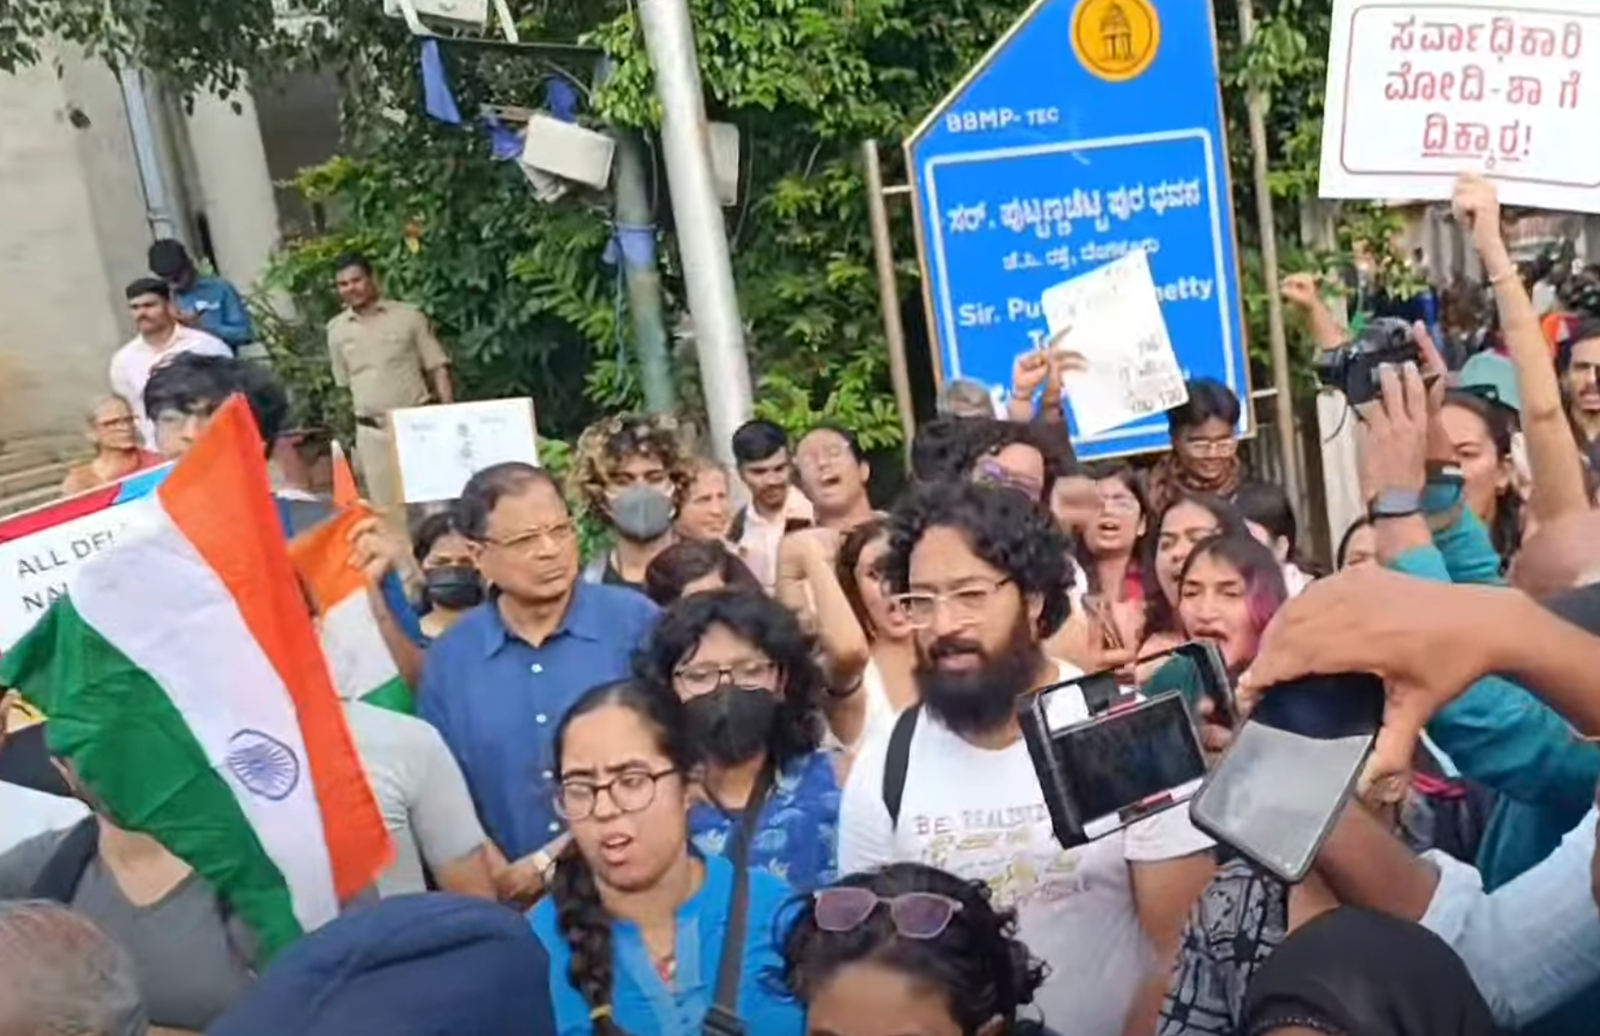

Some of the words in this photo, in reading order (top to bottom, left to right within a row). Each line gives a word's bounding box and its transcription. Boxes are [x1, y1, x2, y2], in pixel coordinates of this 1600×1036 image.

[1390, 15, 1582, 62] ಸರ್ವಾಧಿಕಾರಿ
[1026, 106, 1060, 126] TEC
[958, 303, 1001, 327] Sir.
[17, 549, 68, 579] ALL
